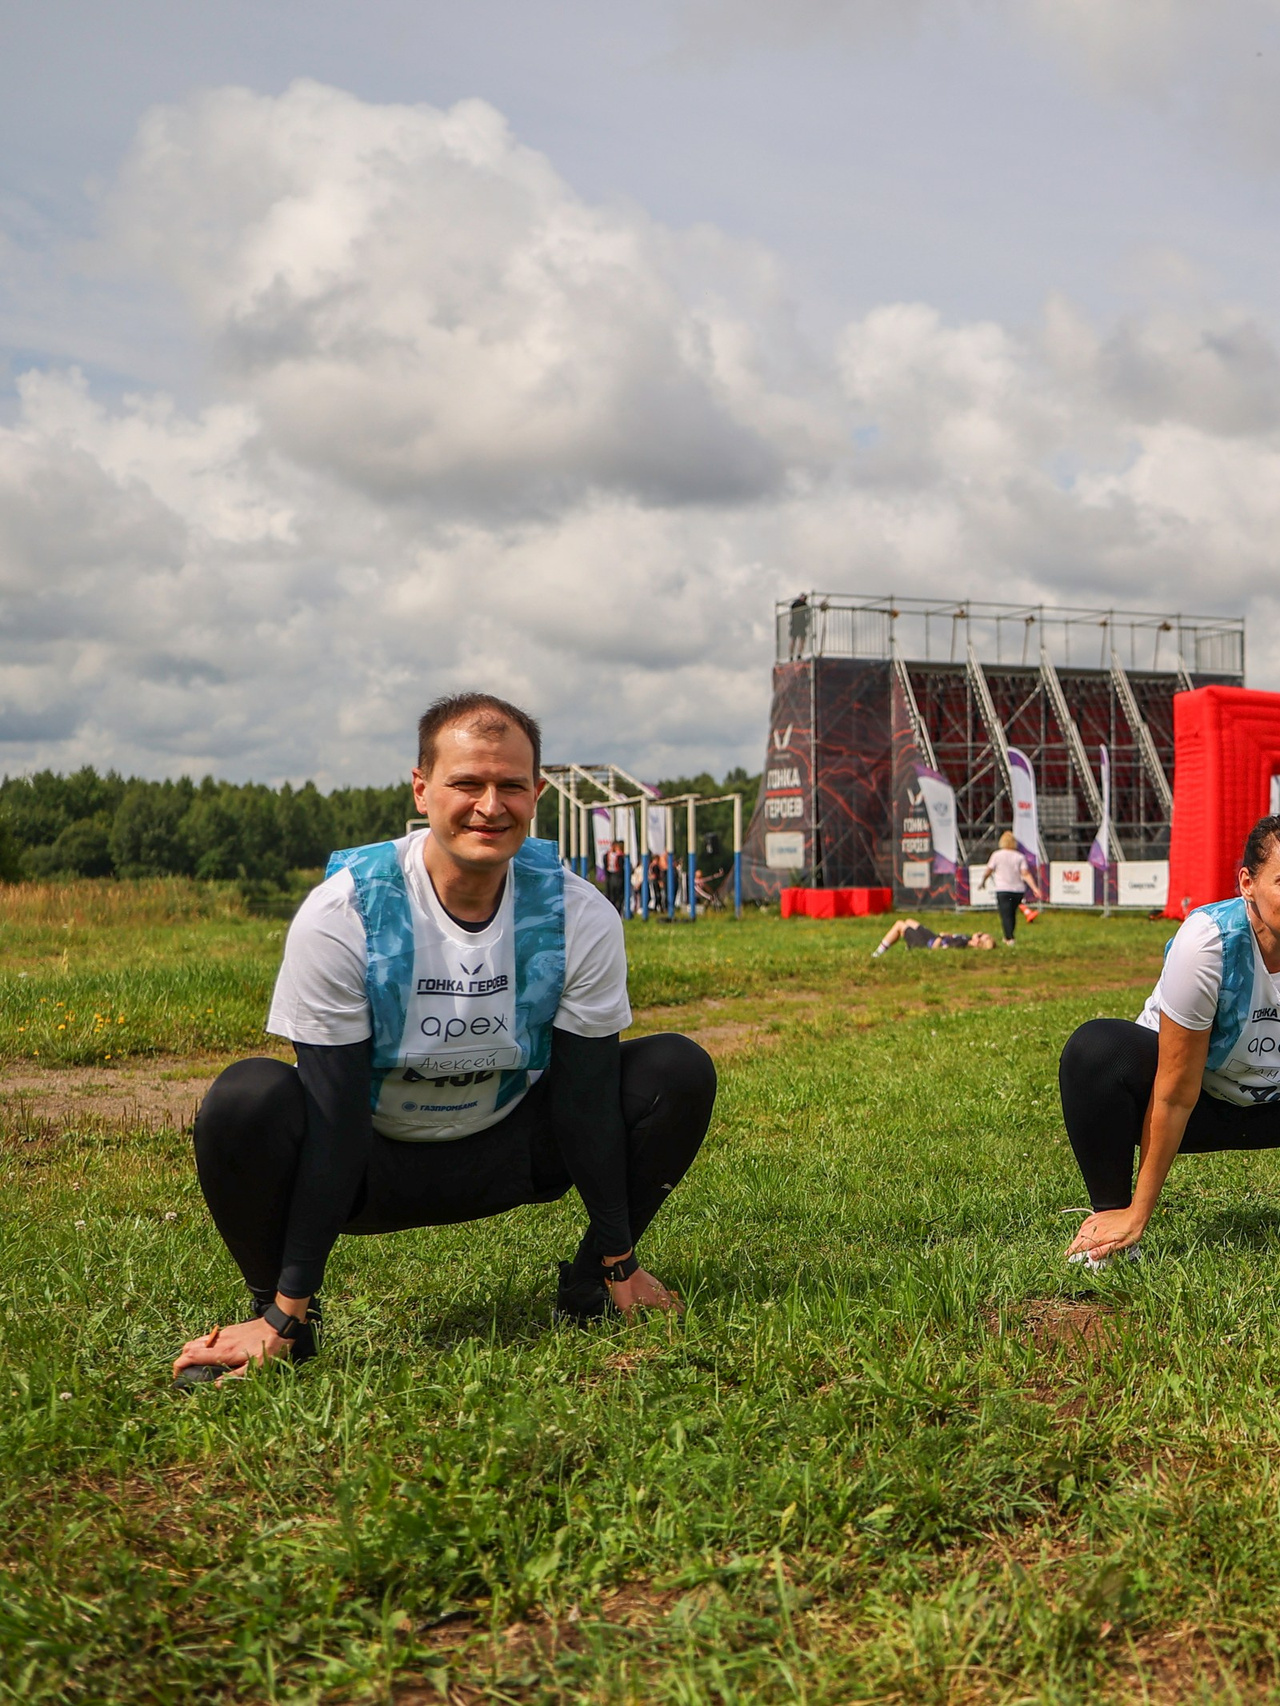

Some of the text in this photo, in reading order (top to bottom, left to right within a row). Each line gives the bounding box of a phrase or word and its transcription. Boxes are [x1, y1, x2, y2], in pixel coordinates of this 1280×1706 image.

[767, 767, 801, 789] ГОНКА
[765, 797, 803, 818] ГЕРОЕВ
[417, 975, 508, 992] ГОНКА ГЕРОЕВ
[1252, 1007, 1278, 1019] ГОНКА
[421, 1013, 508, 1042] apex
[418, 1051, 498, 1071] Алексей
[420, 1100, 478, 1112] ГАЗПРОМБАНК
